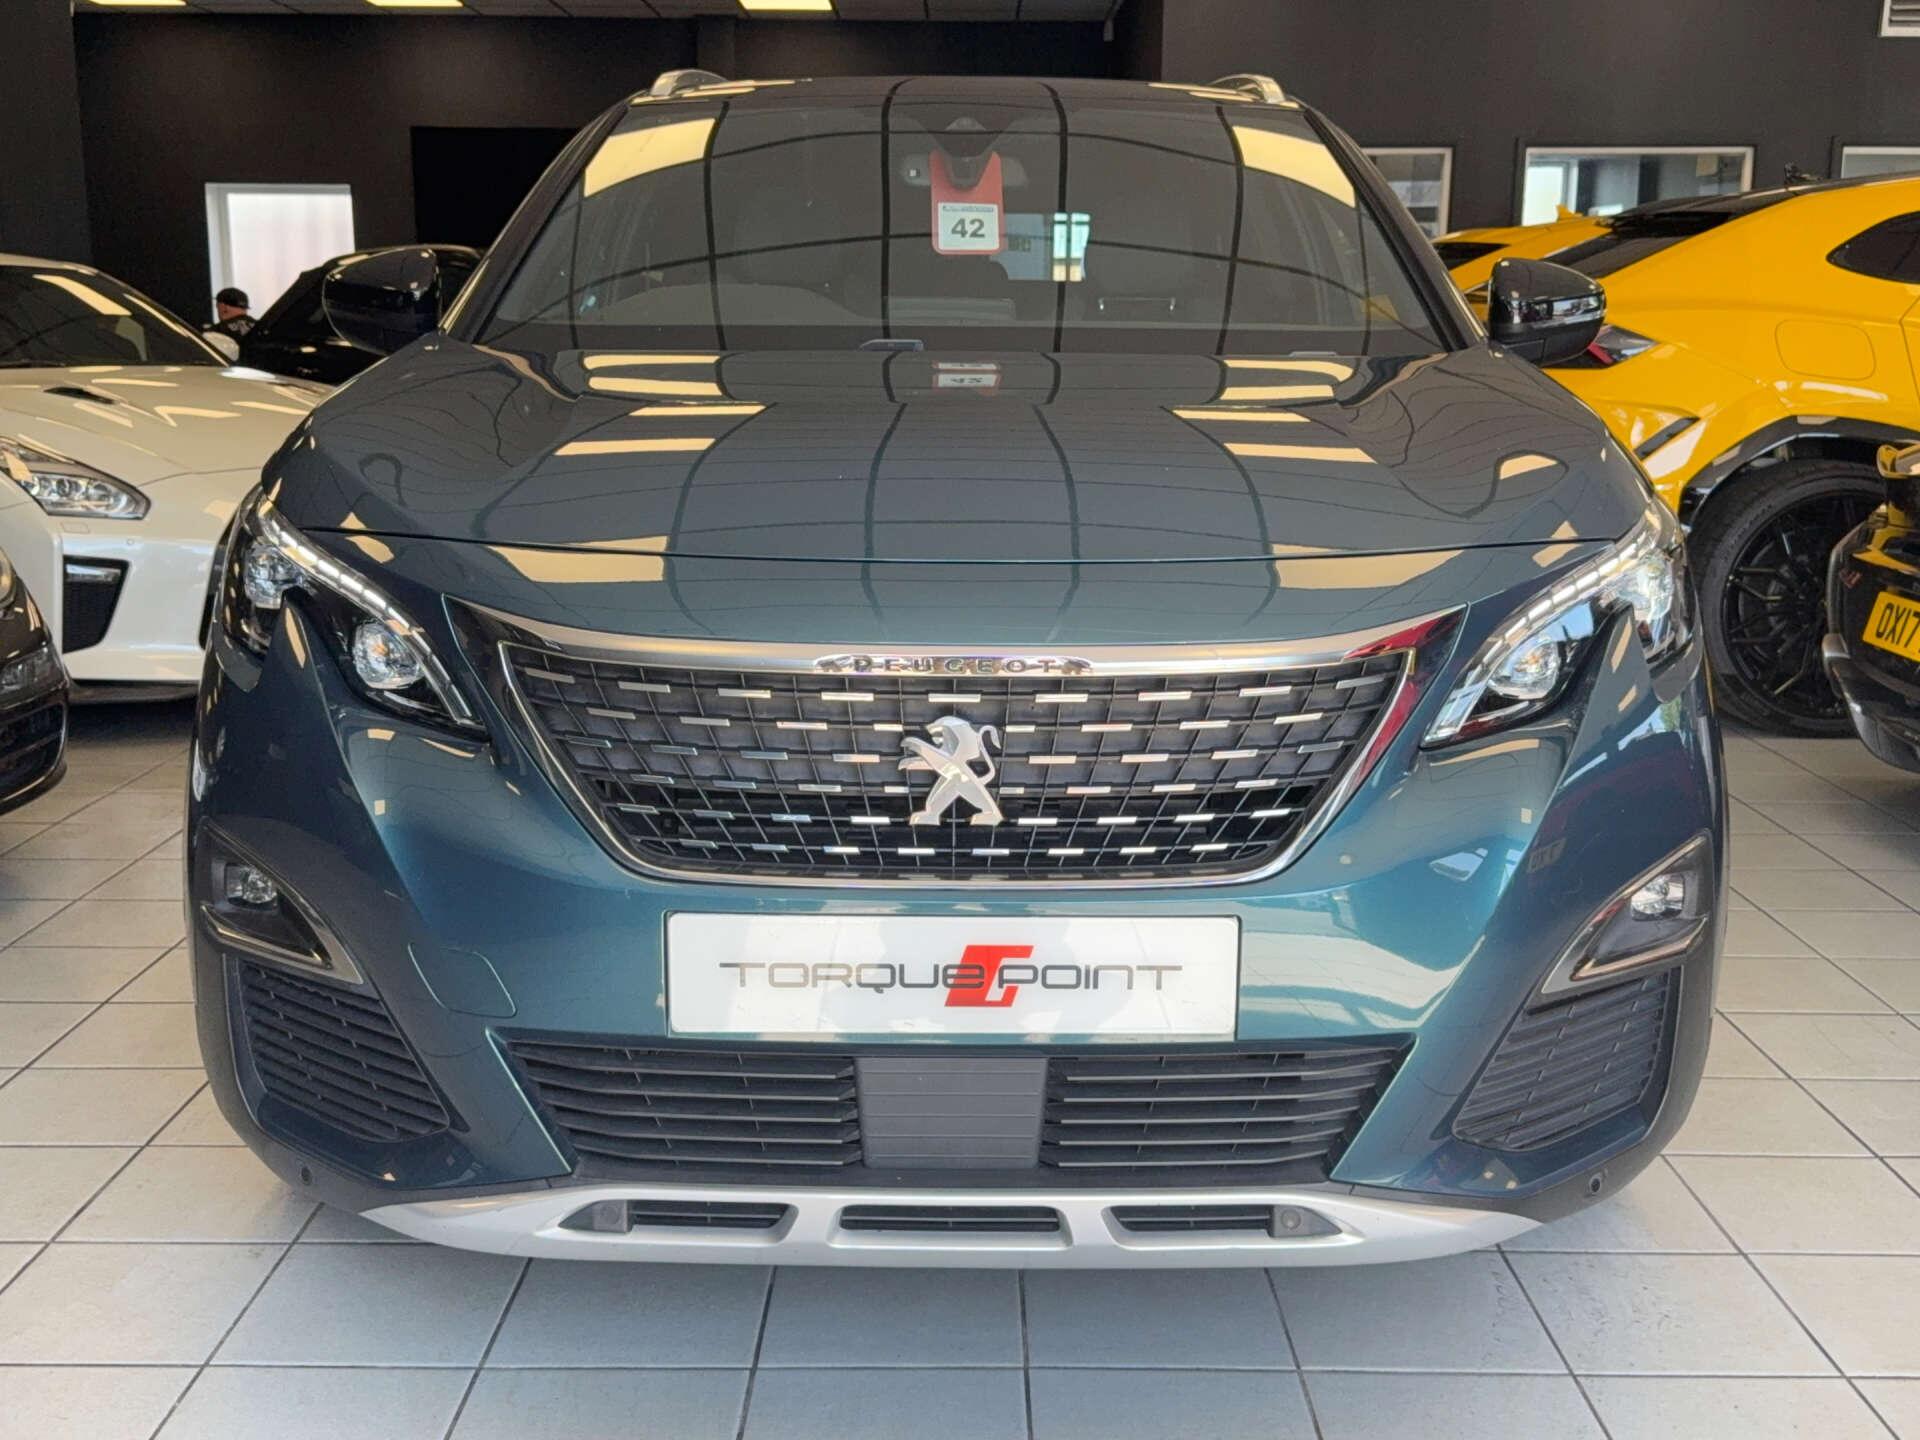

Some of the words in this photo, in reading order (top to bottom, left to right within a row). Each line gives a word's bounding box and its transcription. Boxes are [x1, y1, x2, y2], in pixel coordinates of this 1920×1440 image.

[951, 218, 985, 238] 42
[852, 657, 1057, 674] PEUGEOT
[719, 962, 984, 993] TORQUE
